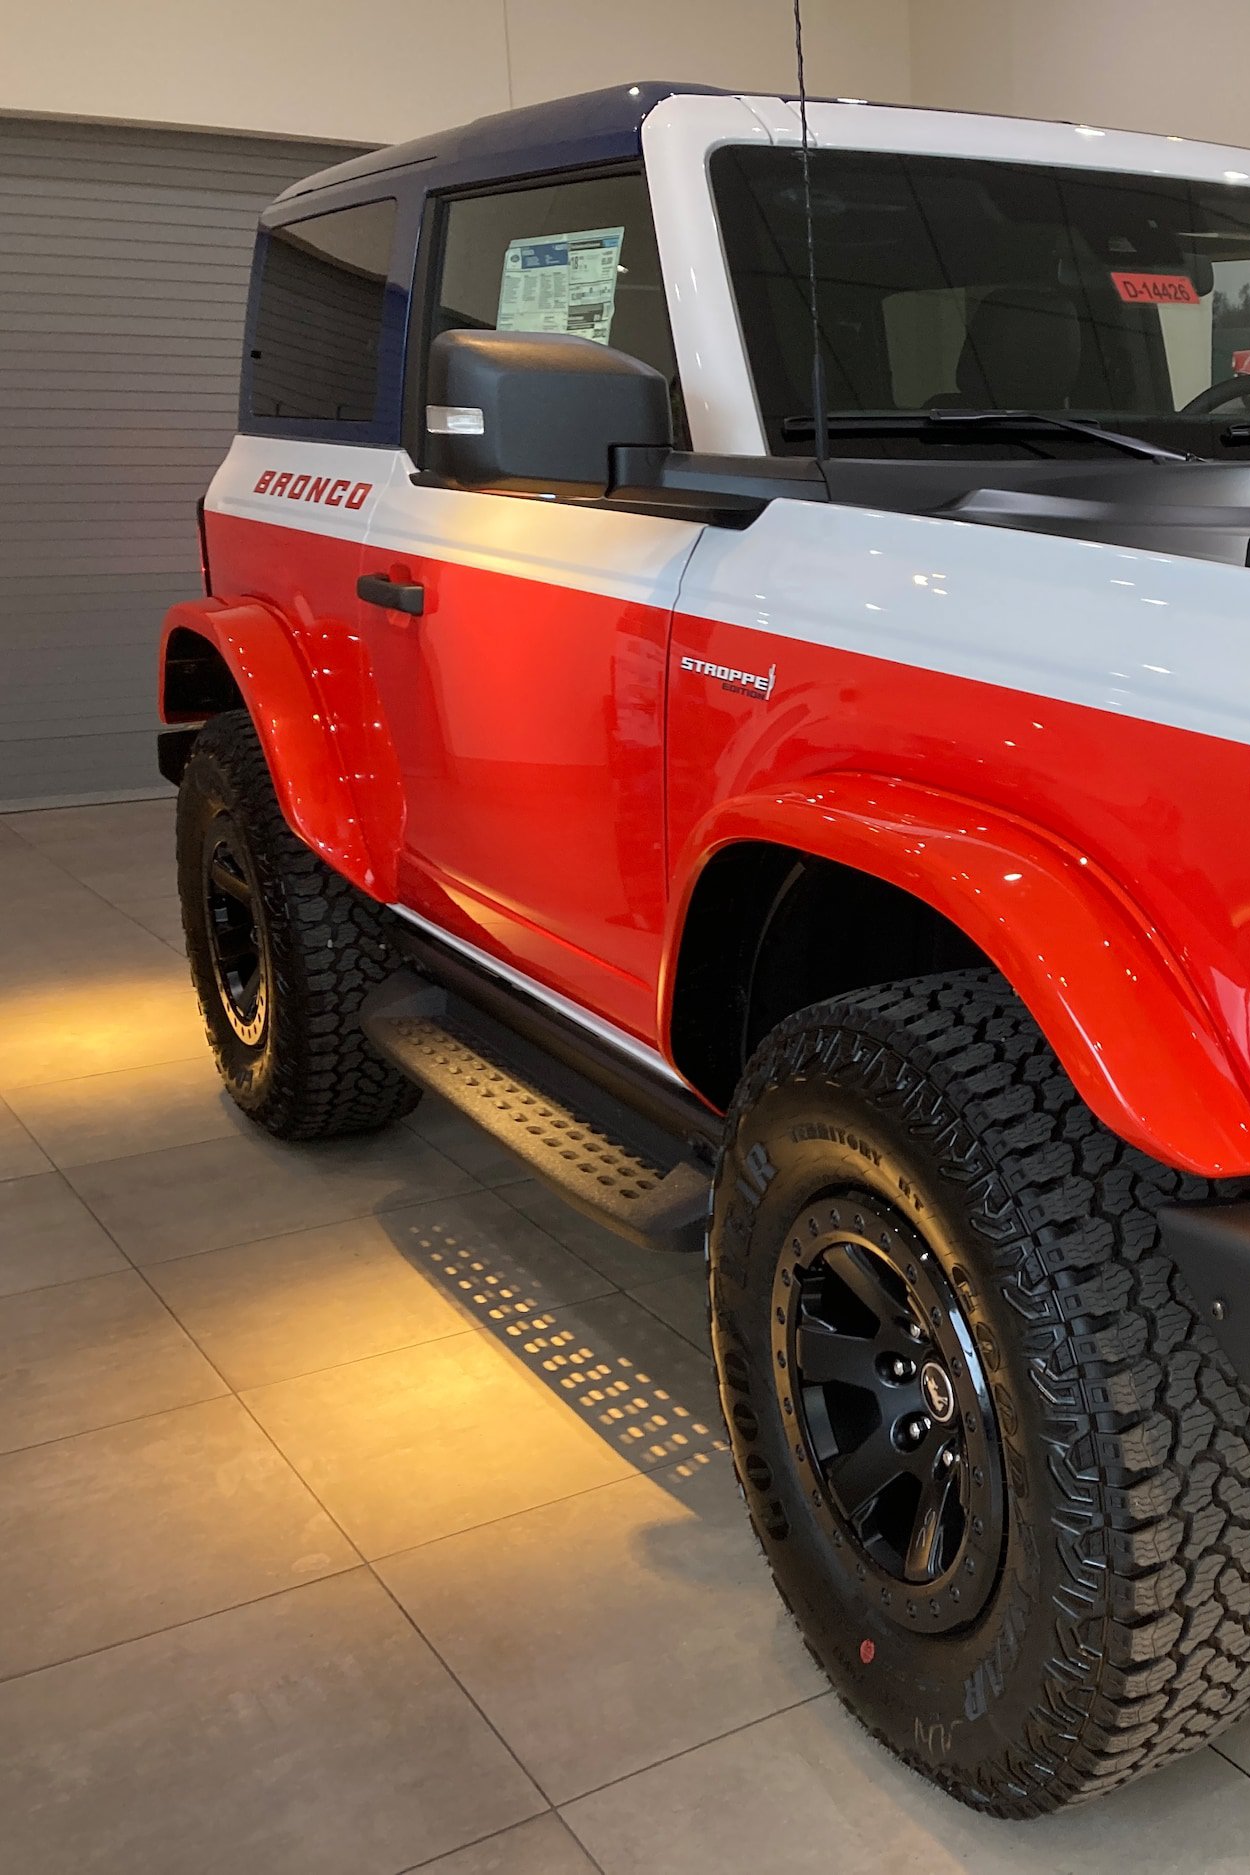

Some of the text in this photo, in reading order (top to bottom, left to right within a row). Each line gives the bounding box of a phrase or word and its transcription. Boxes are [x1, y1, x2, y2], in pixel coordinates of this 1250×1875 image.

[1123, 281, 1191, 301] D-14426
[253, 470, 373, 510] BRONCO
[681, 656, 769, 691] STROPPE
[722, 682, 768, 701] EDITION
[791, 1121, 882, 1167] TERRITORY
